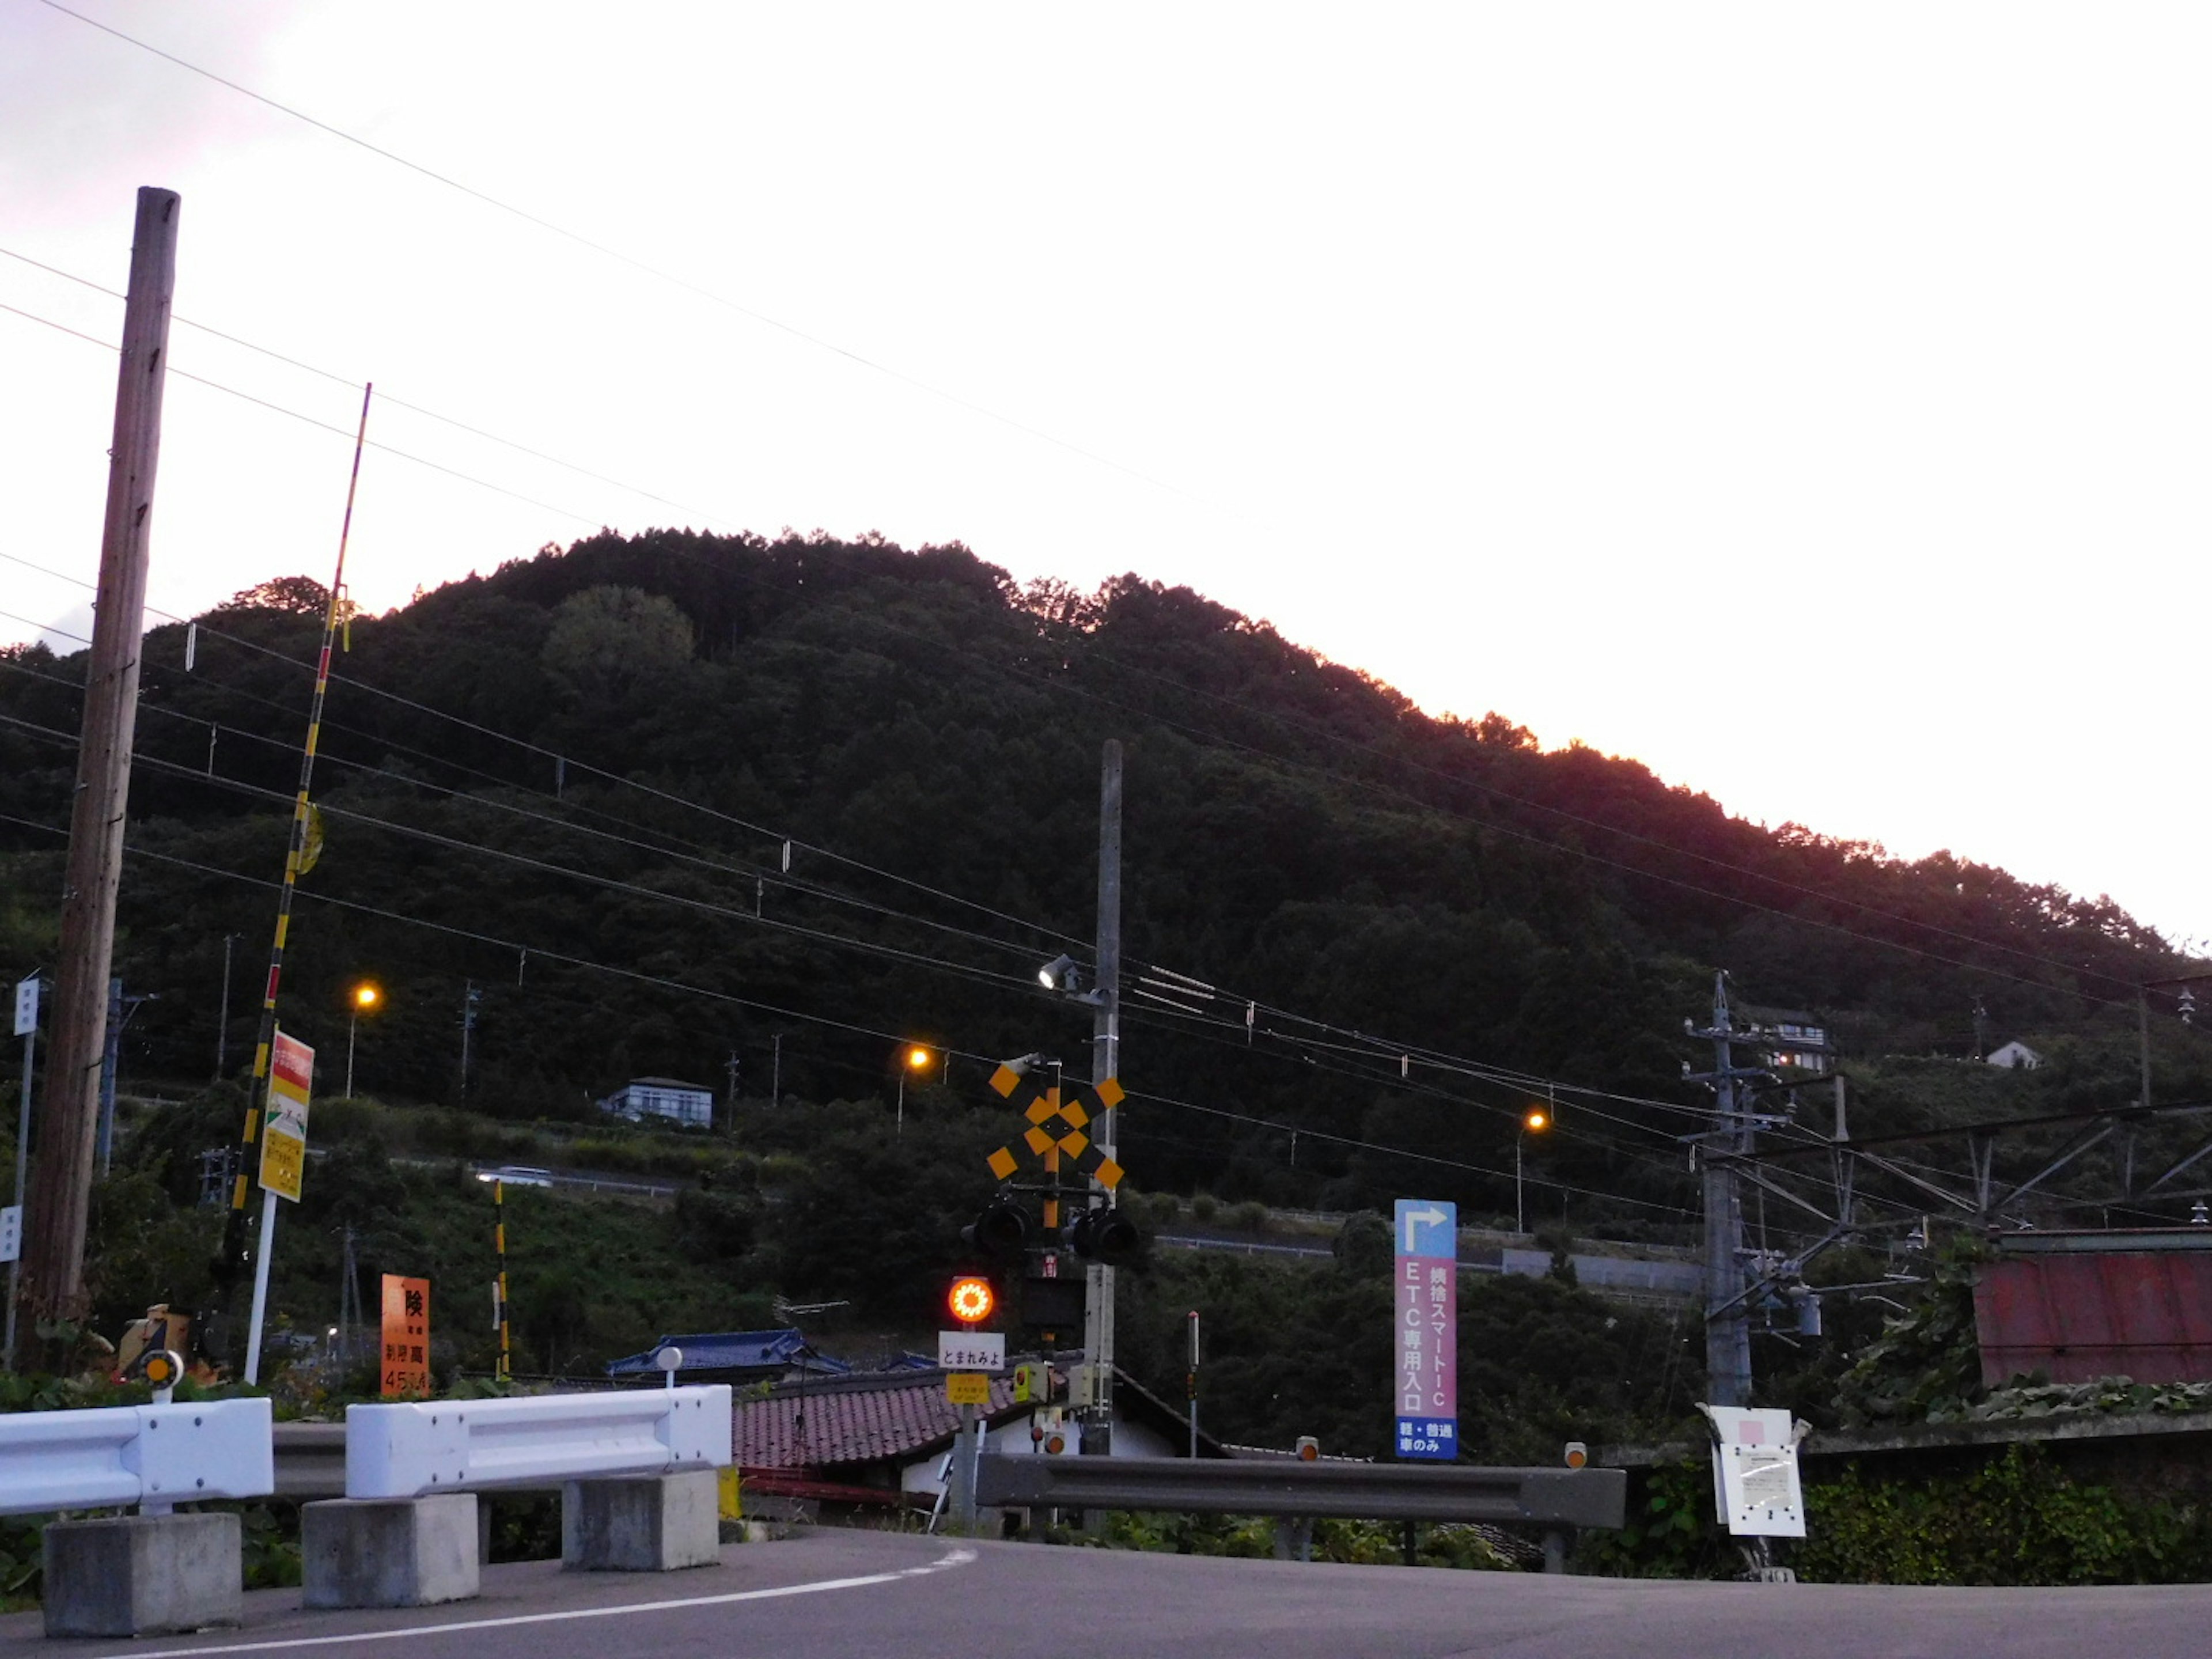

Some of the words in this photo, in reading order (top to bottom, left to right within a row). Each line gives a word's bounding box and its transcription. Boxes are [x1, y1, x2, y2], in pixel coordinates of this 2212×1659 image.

[1403, 1262, 1422, 1412] ETC専用入口
[944, 1350, 999, 1366] とまれみよ
[1400, 1421, 1453, 1438] 軽・普通
[1400, 1437, 1440, 1452] 車のみ
